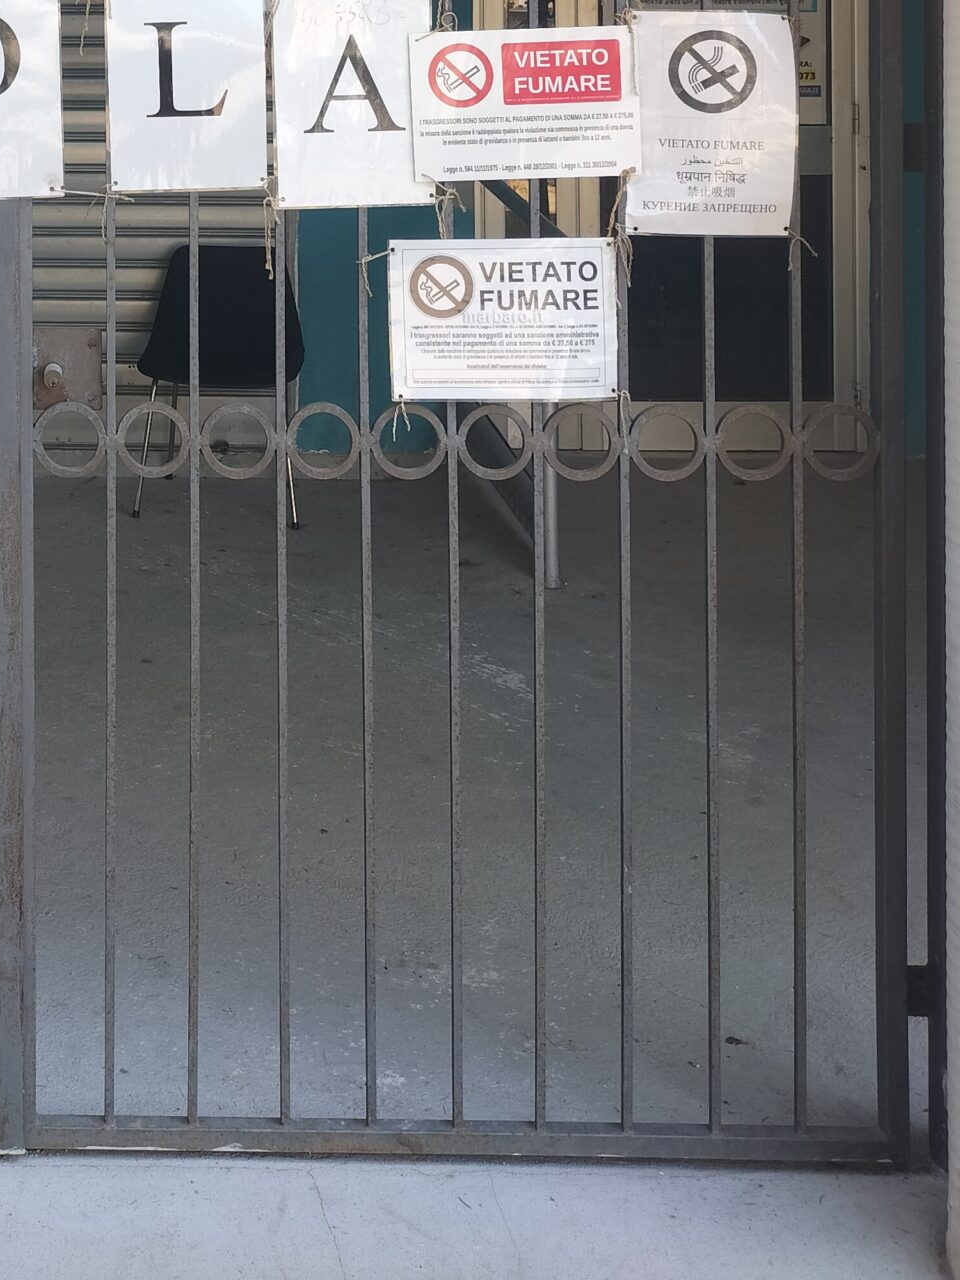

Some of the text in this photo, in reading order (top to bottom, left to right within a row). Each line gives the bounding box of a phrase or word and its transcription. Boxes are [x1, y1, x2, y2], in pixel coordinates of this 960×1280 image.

[514, 49, 609, 68] VIETATO
[514, 74, 611, 94] FUMARE
[658, 138, 765, 151] VIETATO FUMARE
[642, 201, 777, 214] КУРЕНИЕ ЗАПРЕЩЕНО
[479, 261, 598, 283] VIETATO
[480, 289, 599, 311] FUMARE
